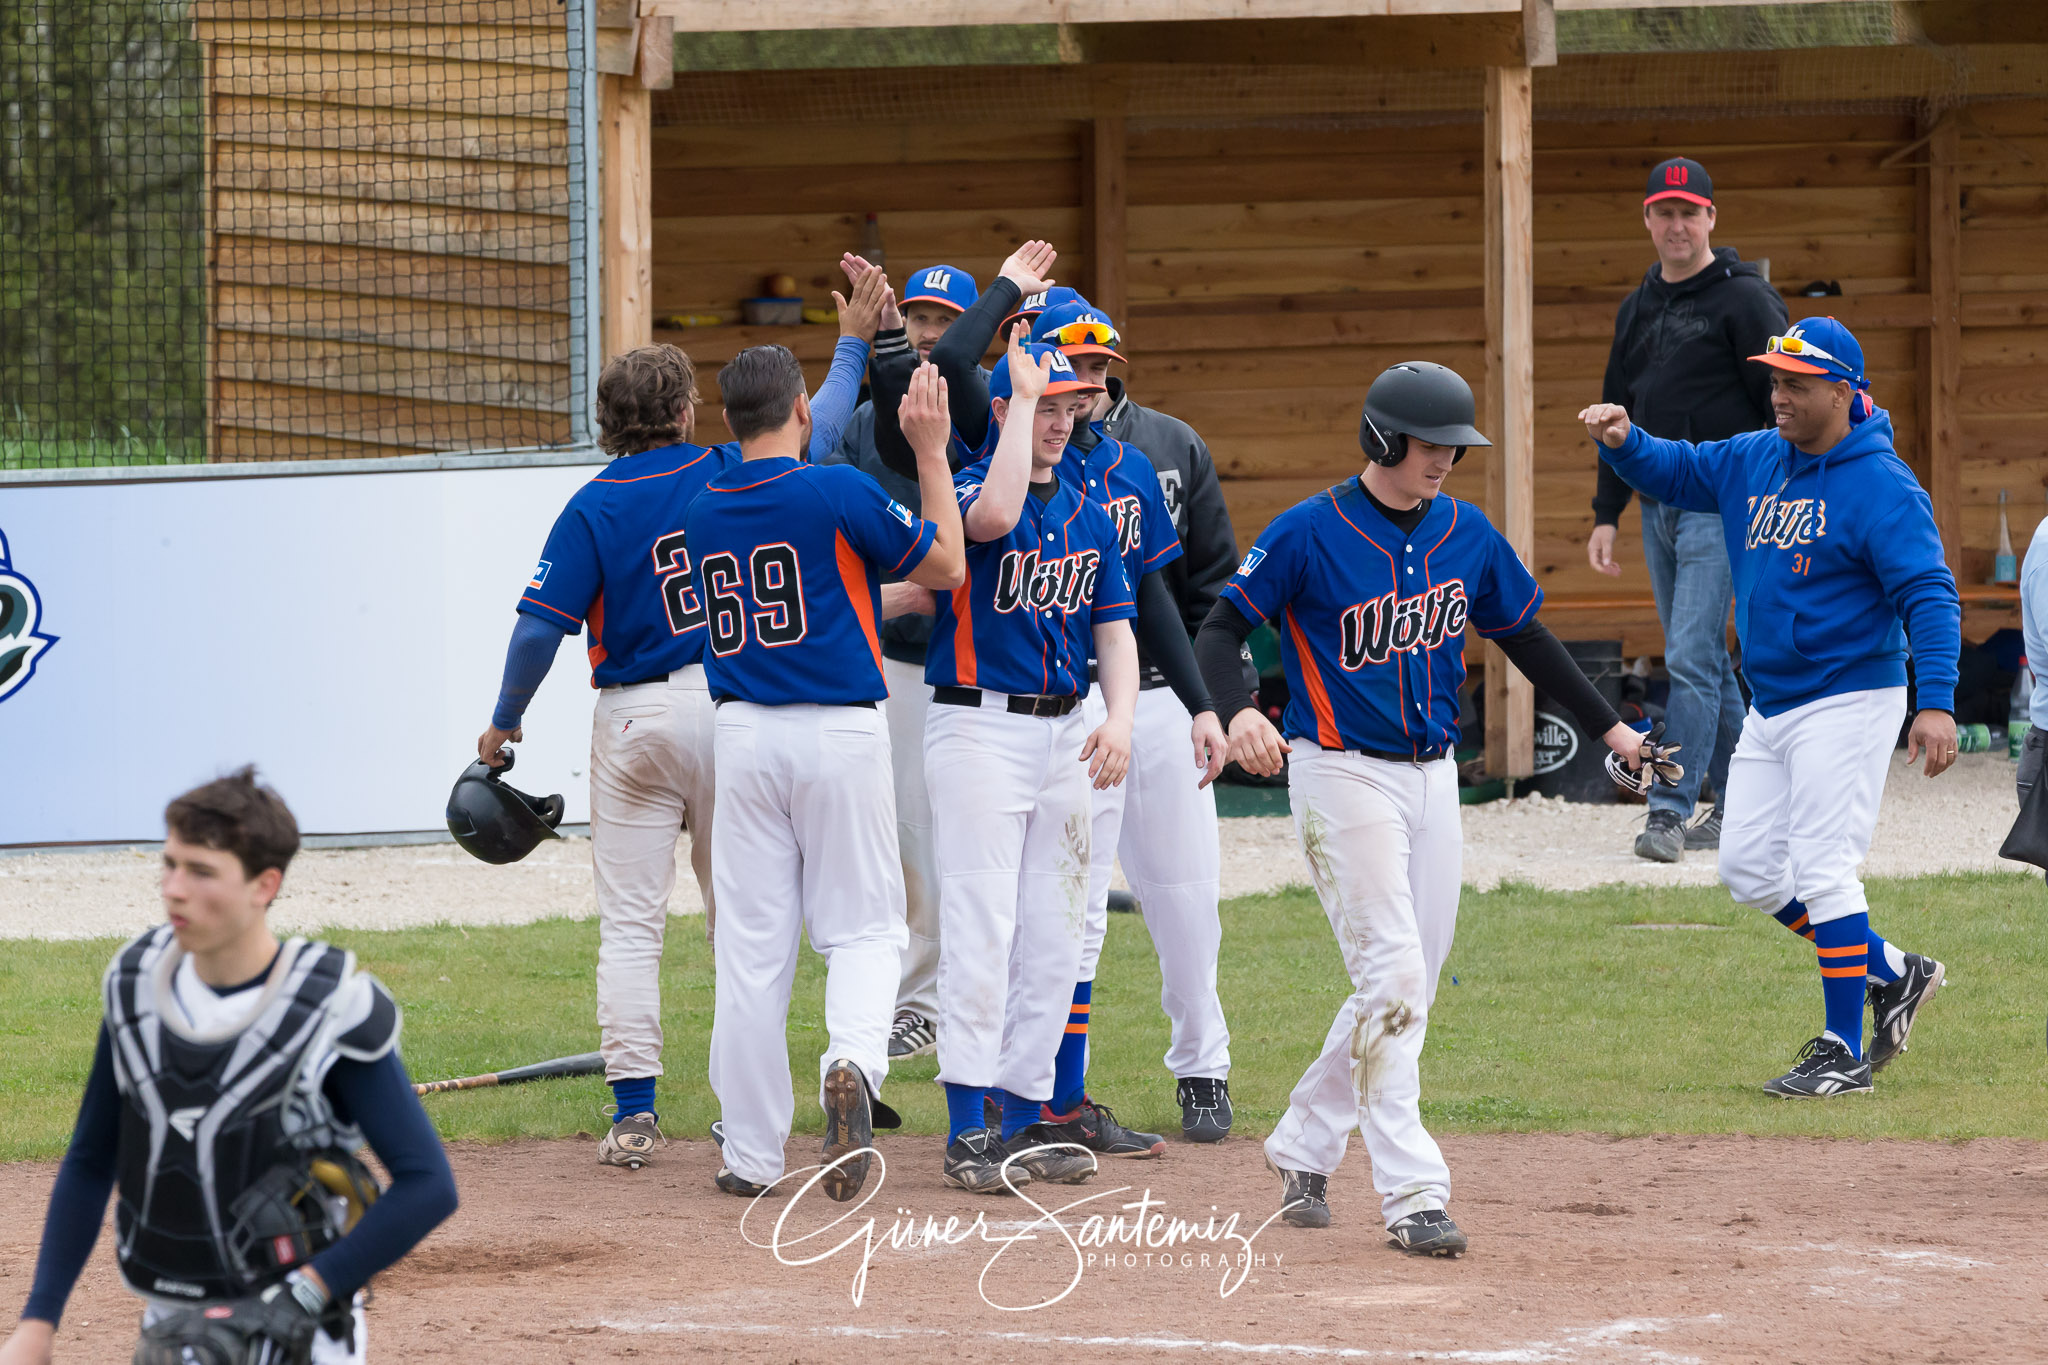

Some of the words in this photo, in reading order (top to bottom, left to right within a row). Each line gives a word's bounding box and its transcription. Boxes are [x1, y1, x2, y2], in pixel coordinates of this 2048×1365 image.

[1101, 494, 1142, 558] lfe
[993, 548, 1101, 615] Wölfe
[1791, 553, 1811, 577] 31
[700, 541, 808, 658] 69
[1338, 577, 1468, 672] Wölfe
